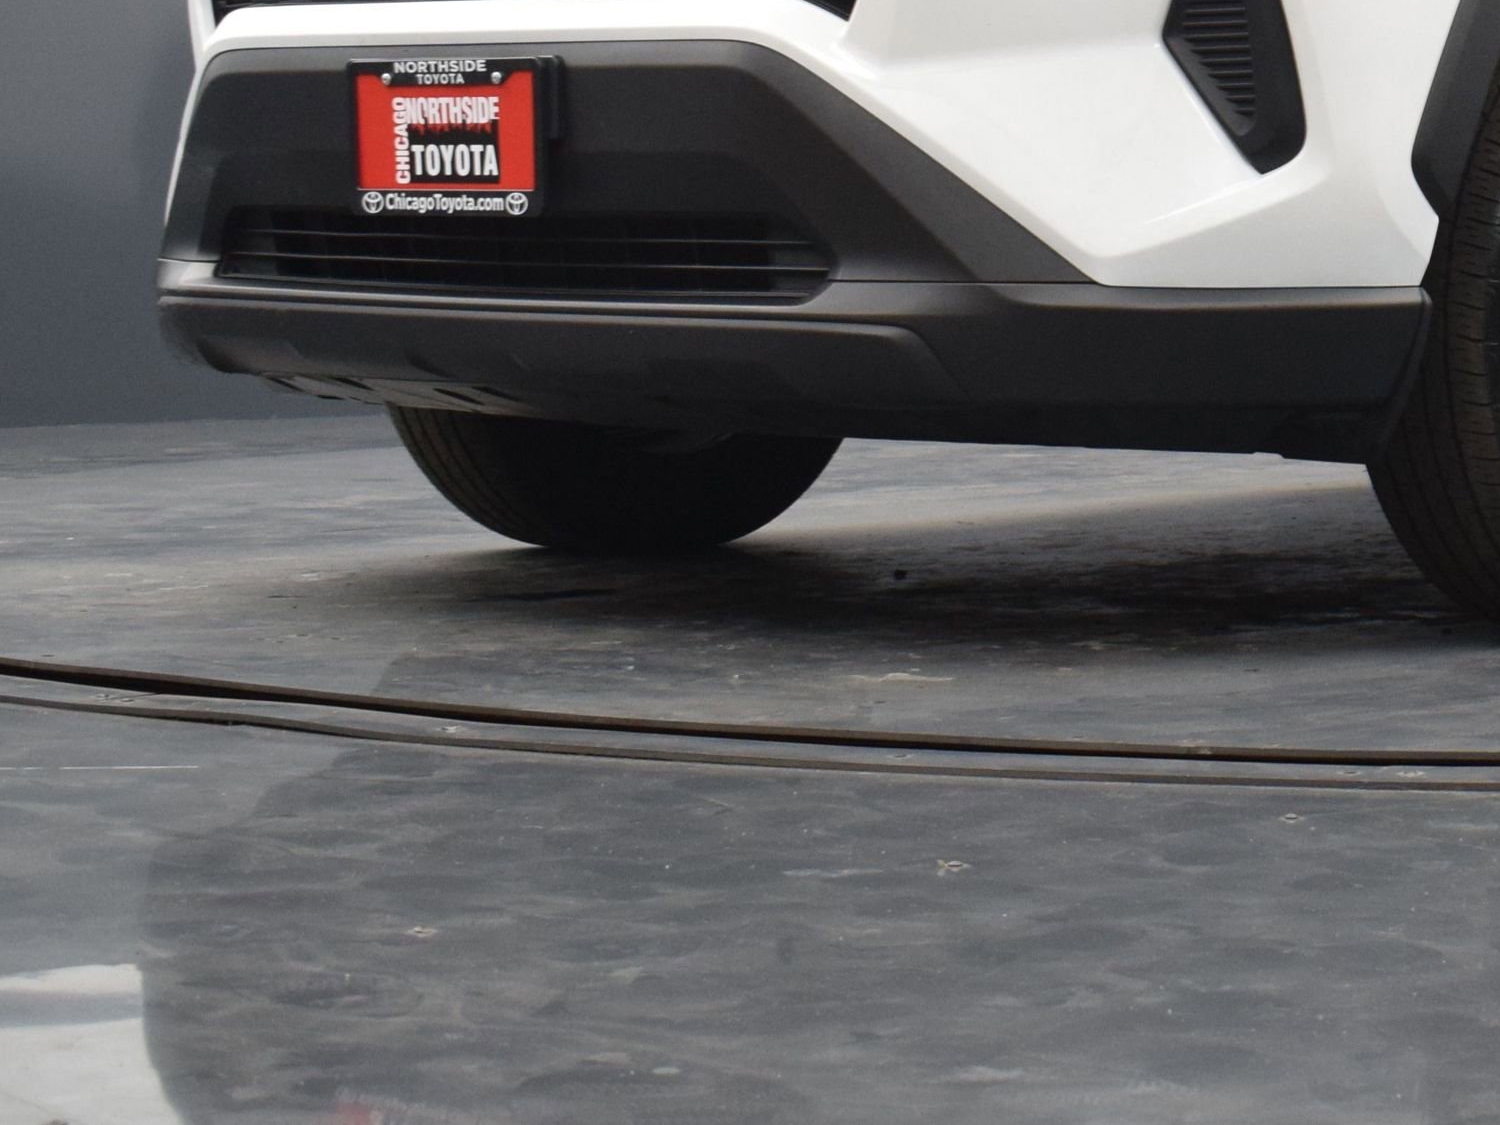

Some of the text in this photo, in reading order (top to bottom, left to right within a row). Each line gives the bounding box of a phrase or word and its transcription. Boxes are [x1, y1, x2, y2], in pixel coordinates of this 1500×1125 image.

[393, 59, 487, 73] NORTHSIDE
[416, 73, 465, 85] TOYOTA
[405, 96, 500, 125] NORTHSIDE
[391, 96, 412, 185] CHICAGO
[410, 144, 499, 177] TOYOTA
[384, 193, 505, 214] ChicagoToyota.com
